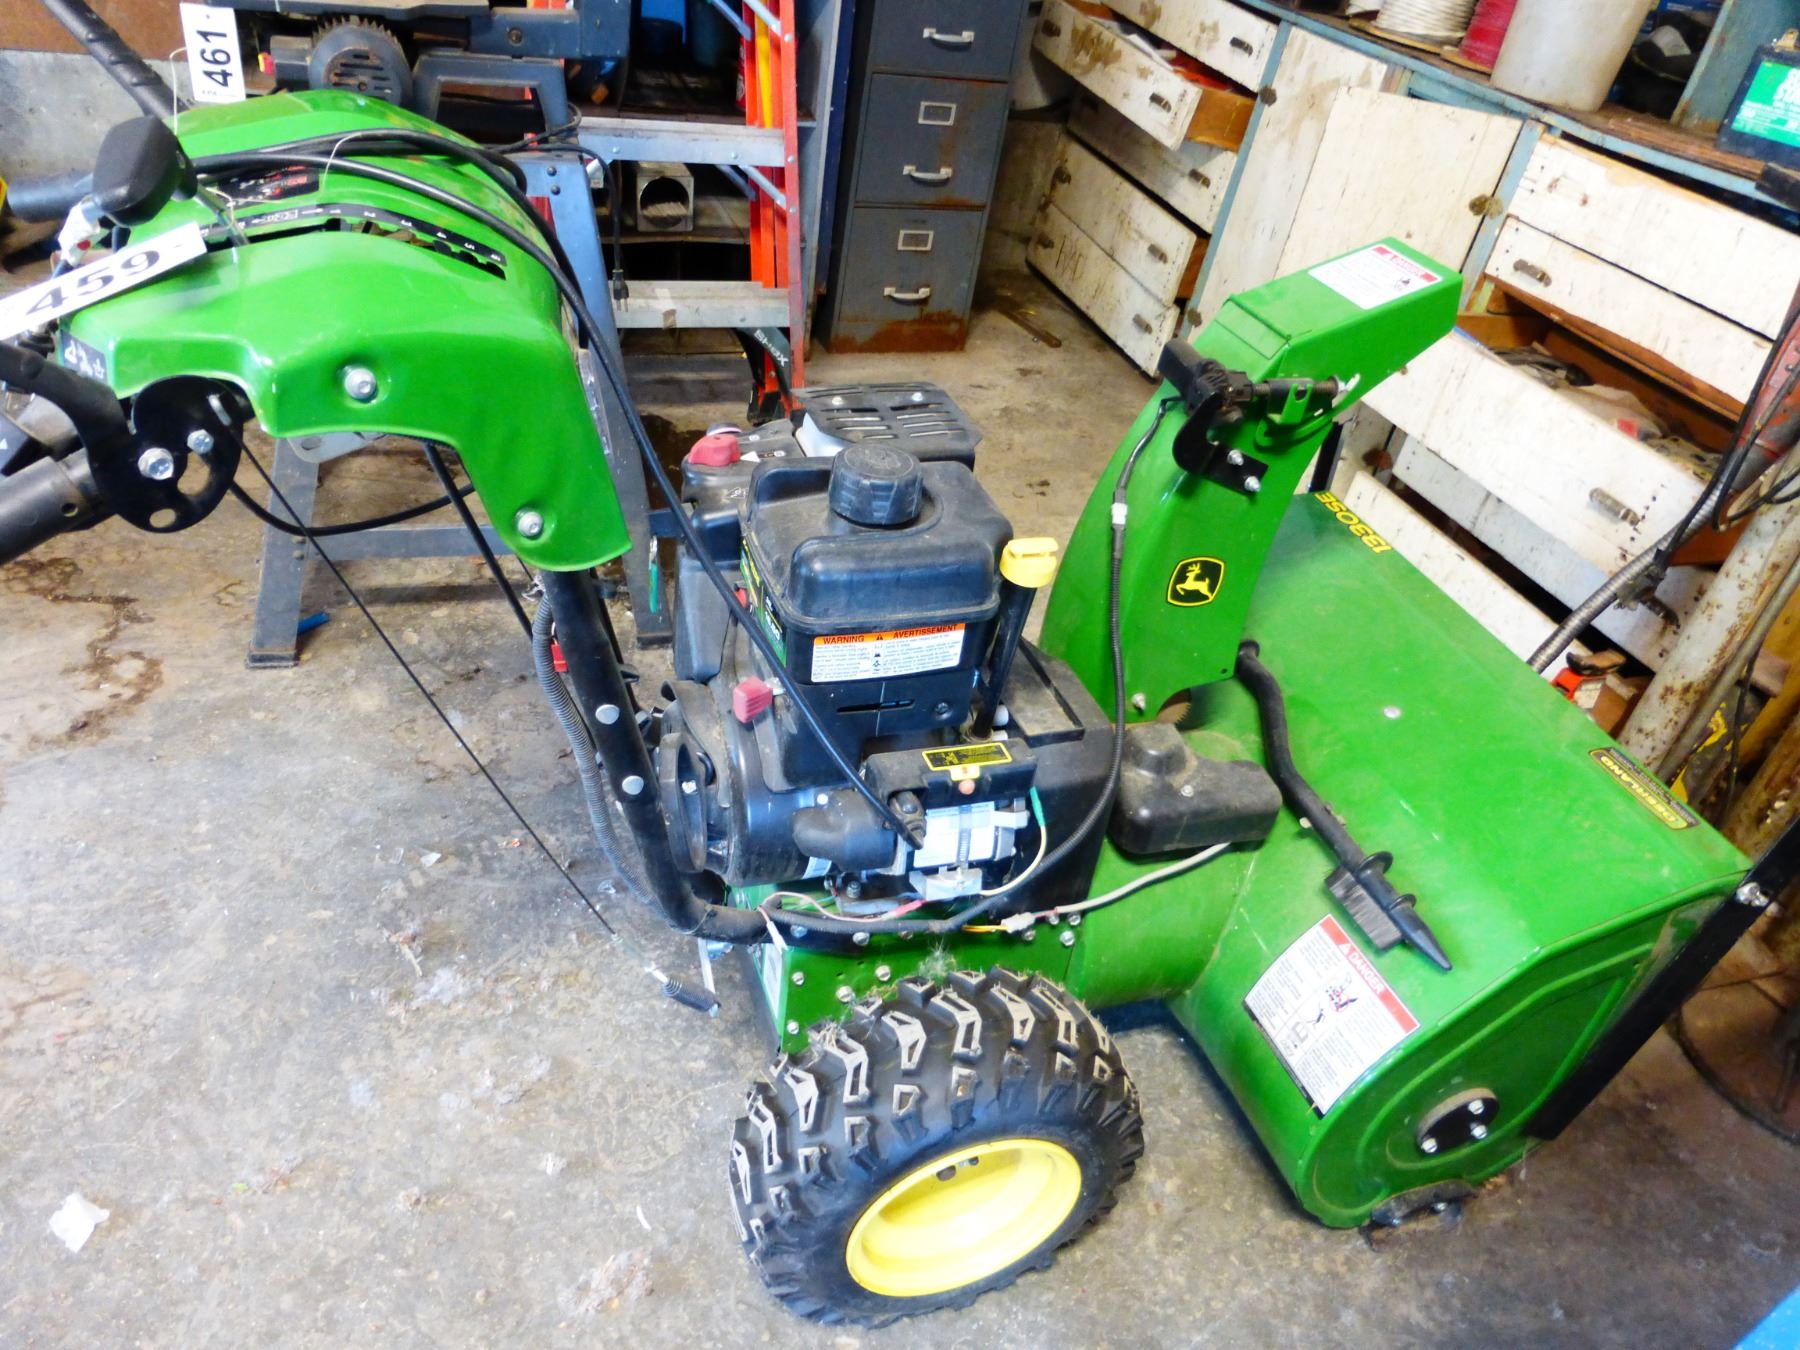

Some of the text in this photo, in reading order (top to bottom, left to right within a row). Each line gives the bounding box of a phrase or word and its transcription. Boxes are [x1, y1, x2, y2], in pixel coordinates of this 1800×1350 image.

[196, 29, 233, 88] 461
[26, 249, 160, 315] 459
[1313, 491, 1393, 554] 1330SE
[822, 624, 958, 645] WARNING AVERTISSEMENT
[1347, 951, 1386, 995] DANGER
